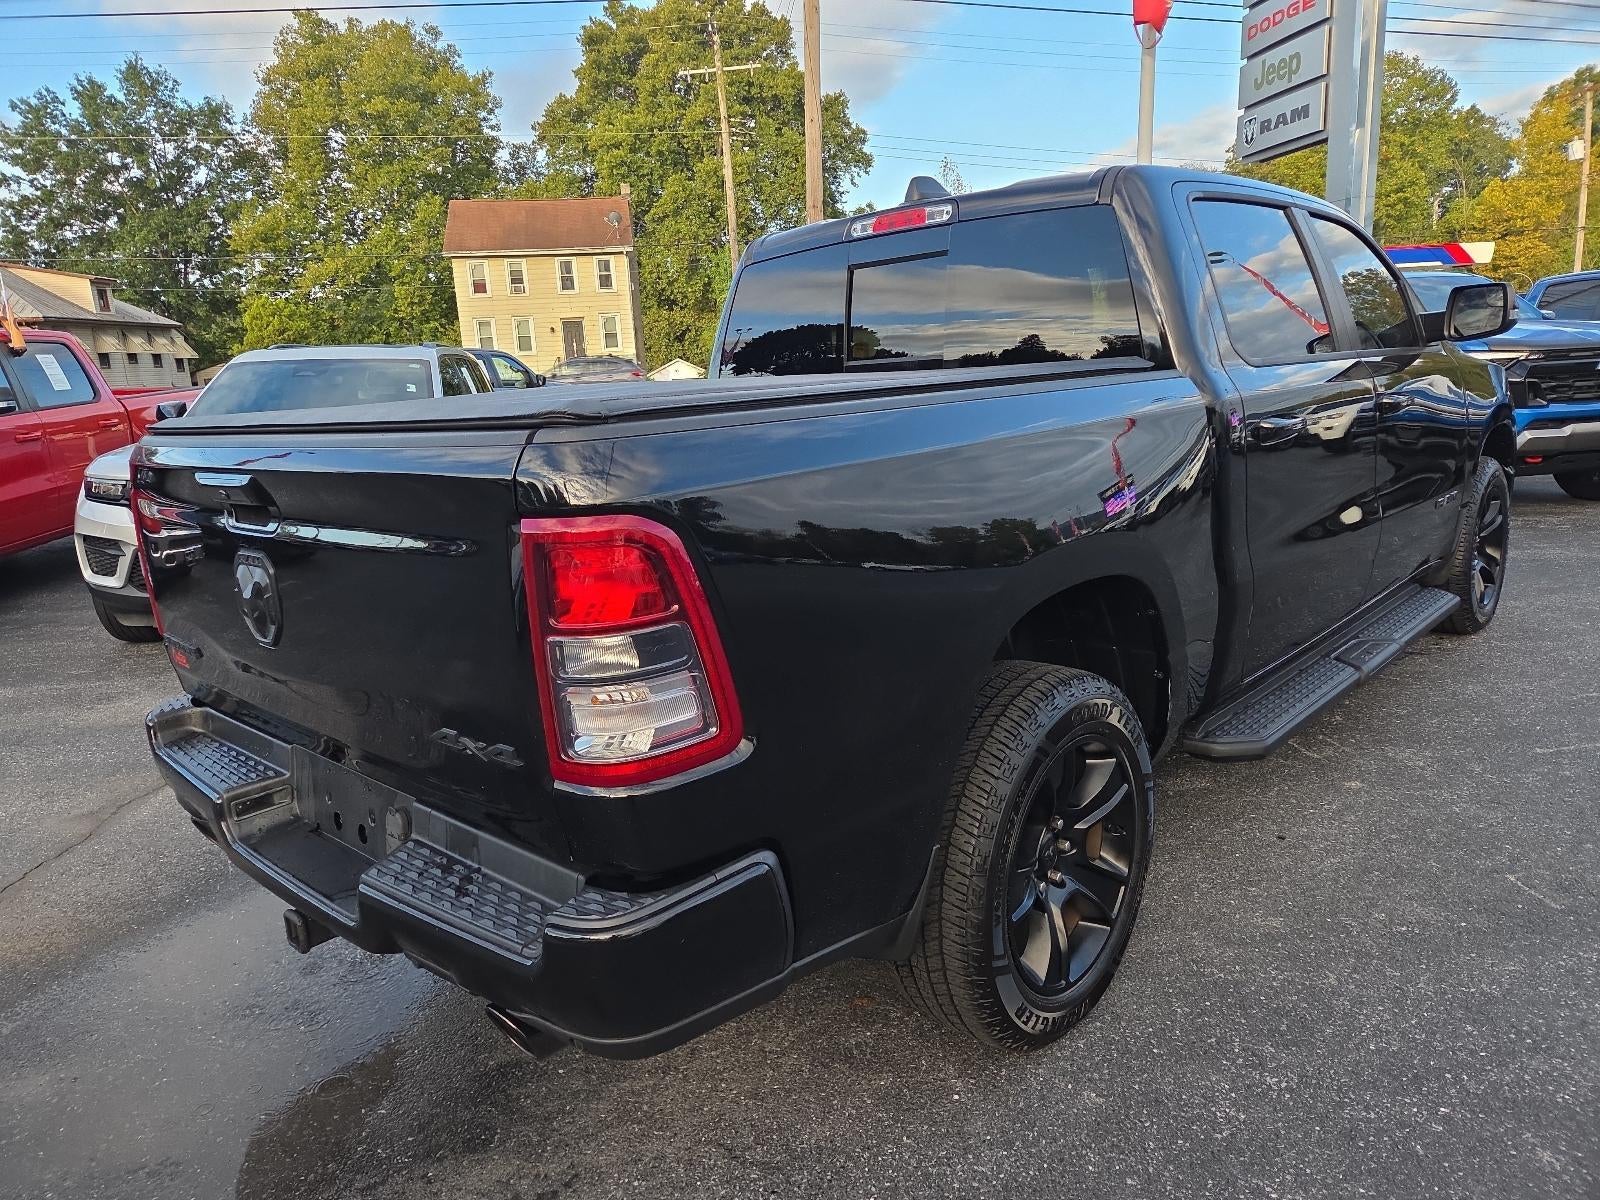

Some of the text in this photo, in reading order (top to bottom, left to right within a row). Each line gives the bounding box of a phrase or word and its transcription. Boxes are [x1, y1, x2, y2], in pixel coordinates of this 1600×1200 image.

[1247, 0, 1317, 42] DODGE
[1253, 51, 1302, 91] Jeep
[1259, 103, 1310, 135] RAM
